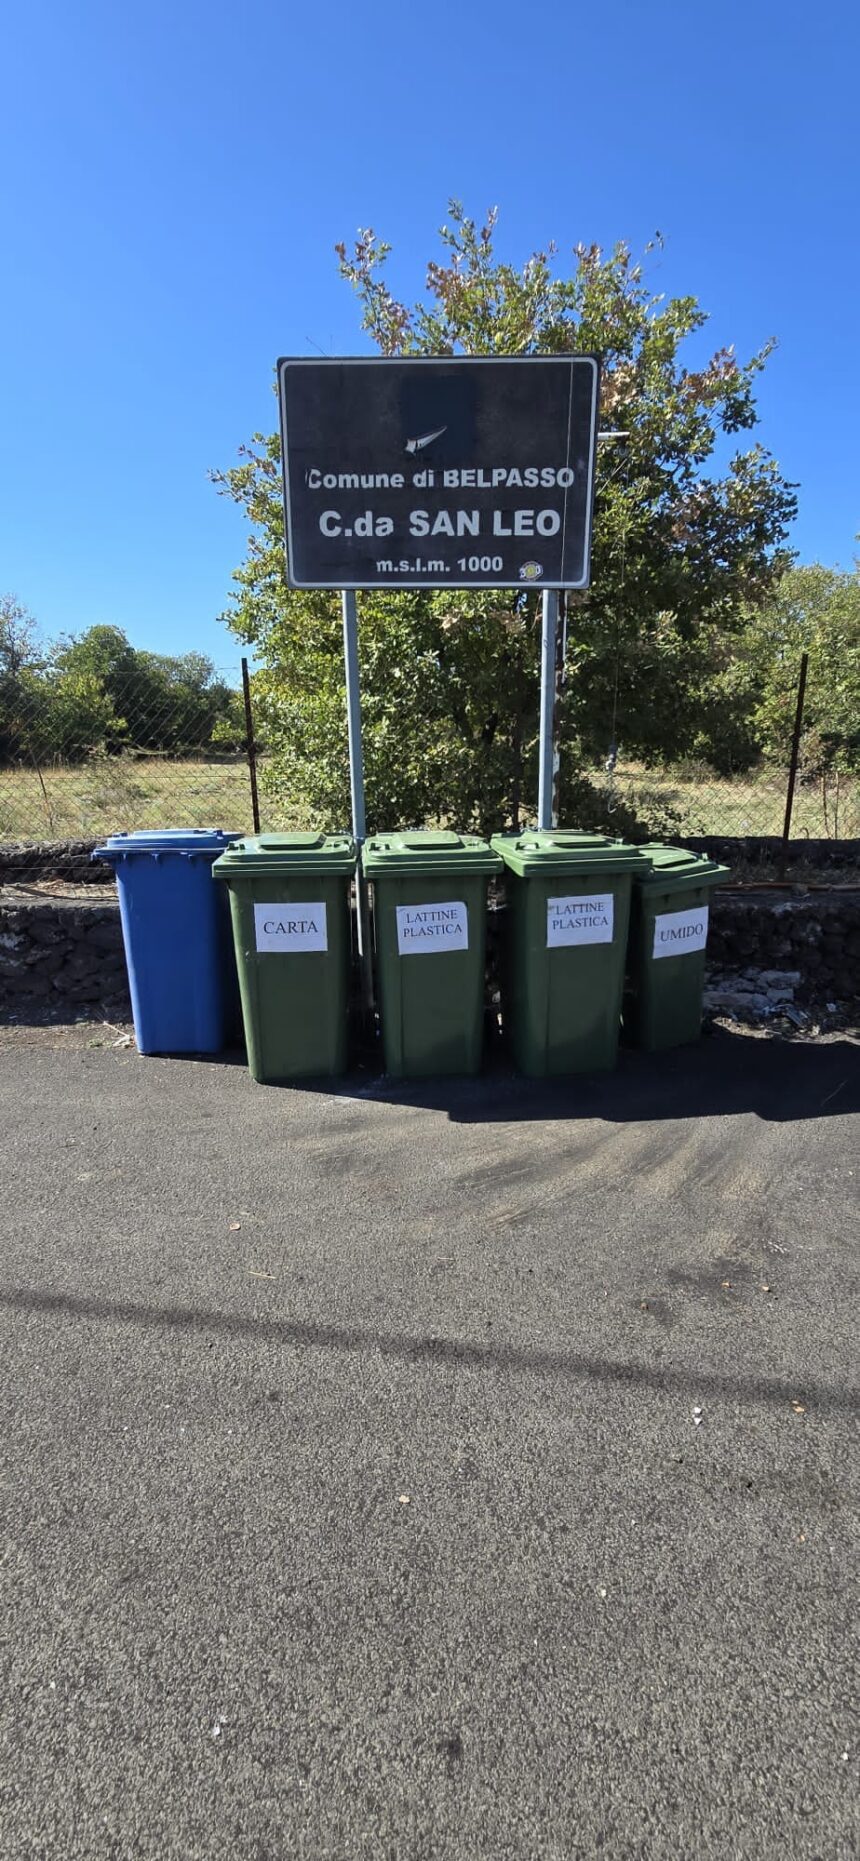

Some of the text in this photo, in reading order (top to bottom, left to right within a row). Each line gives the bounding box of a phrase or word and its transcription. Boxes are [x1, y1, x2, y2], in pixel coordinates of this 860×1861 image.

[307, 467, 575, 489] Comune di BELPASSO
[319, 509, 561, 537] C.da SAN LEO
[376, 558, 451, 572] m.s.l.m.
[457, 556, 503, 572] 1000
[406, 909, 458, 923] LATTINE
[556, 902, 604, 916] LATTINE
[263, 920, 318, 935] CARTA
[403, 923, 463, 938] PLASTICA
[552, 916, 609, 930] PLASTICA
[660, 923, 704, 942] UMIDO
